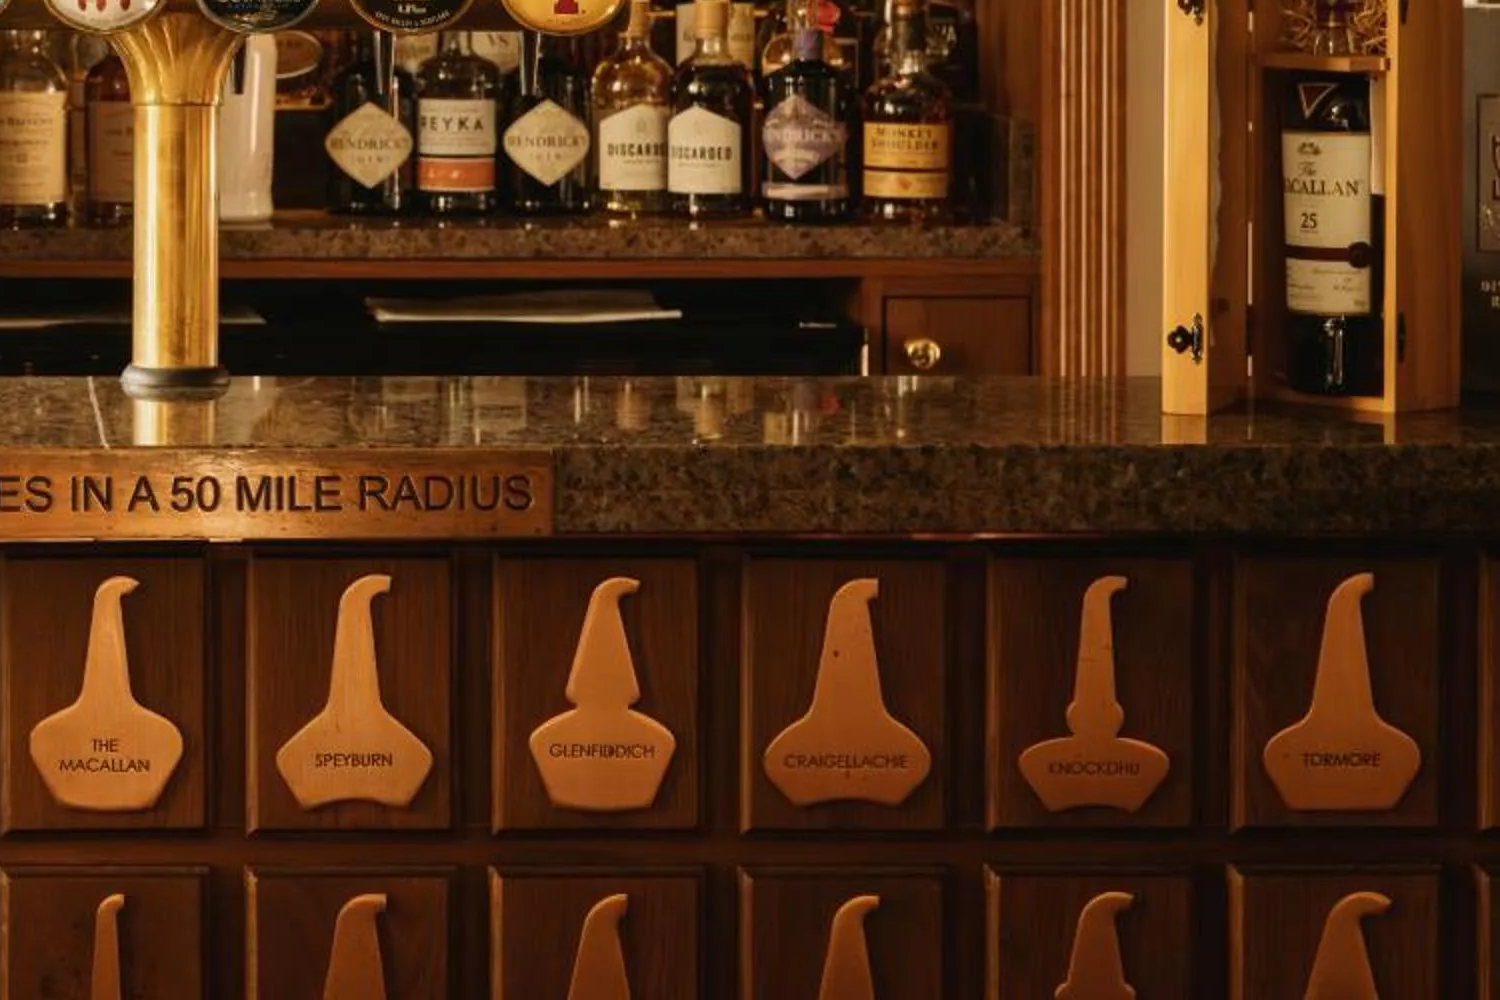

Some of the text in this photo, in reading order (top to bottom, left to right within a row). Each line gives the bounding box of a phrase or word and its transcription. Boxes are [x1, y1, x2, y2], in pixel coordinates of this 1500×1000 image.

[1300, 212, 1318, 230] 25
[71, 475, 114, 513] IN
[127, 474, 161, 513] A
[170, 474, 221, 513] 50
[235, 474, 343, 512] MILE
[358, 473, 536, 512] RADIUS
[91, 737, 120, 753] THE
[548, 742, 656, 760] GLENFIDDICH
[58, 757, 151, 774] MACALLAN
[314, 752, 394, 768] SPEYBURN
[783, 753, 910, 770] CRAIGELLACHIE
[1302, 751, 1383, 768] TORMORE
[1048, 760, 1141, 777] KNOCKDHU
